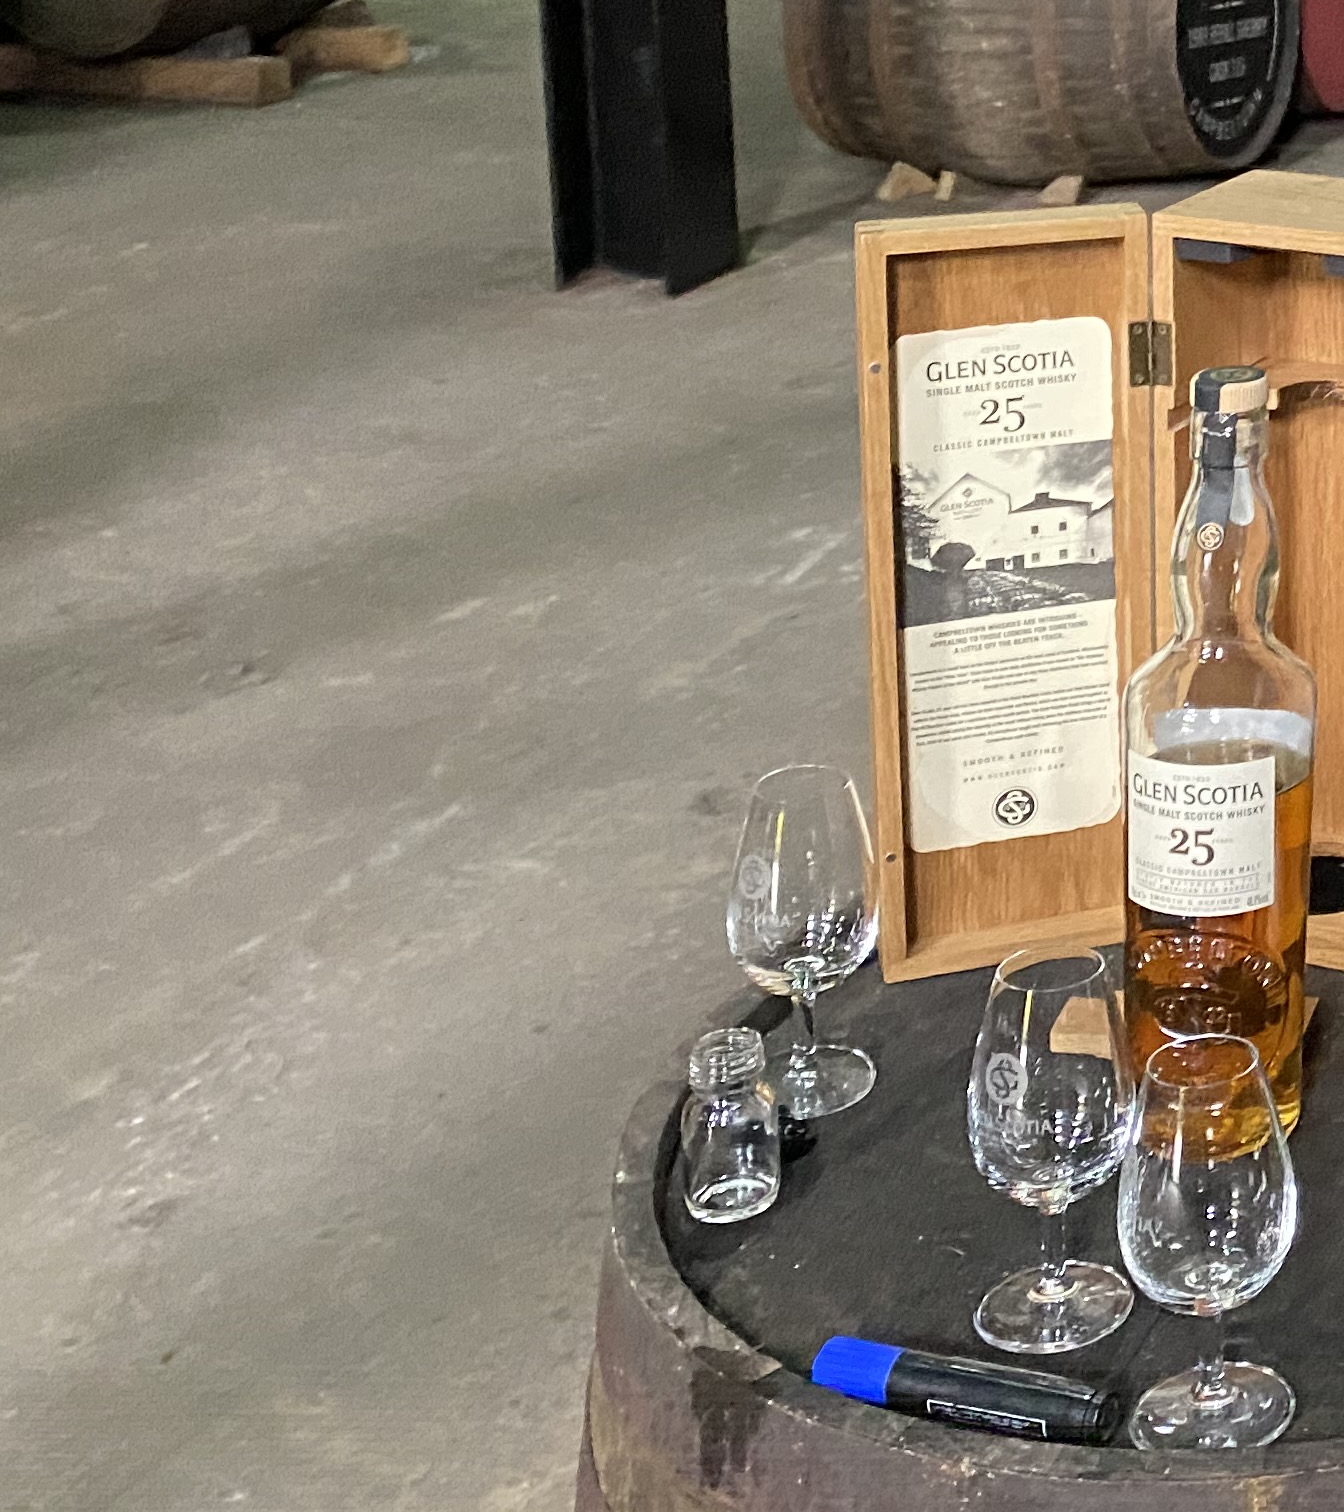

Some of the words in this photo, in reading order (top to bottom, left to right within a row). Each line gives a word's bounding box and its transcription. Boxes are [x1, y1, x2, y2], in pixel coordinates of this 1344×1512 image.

[926, 359, 986, 383] GLEN
[993, 349, 1075, 375] SCOTIA
[926, 386, 961, 398] SINGLE
[965, 382, 992, 393] MALT
[995, 378, 1034, 390] SCOTCH
[1037, 373, 1077, 385] WHISKY
[980, 395, 1025, 432] 25
[1133, 772, 1177, 804] GLEN
[1183, 781, 1263, 806] SCOTIA
[1158, 807, 1181, 820] MALT
[1184, 811, 1223, 821] SCOTCH
[1227, 804, 1266, 820] WHISKY
[1169, 827, 1215, 866] 25
